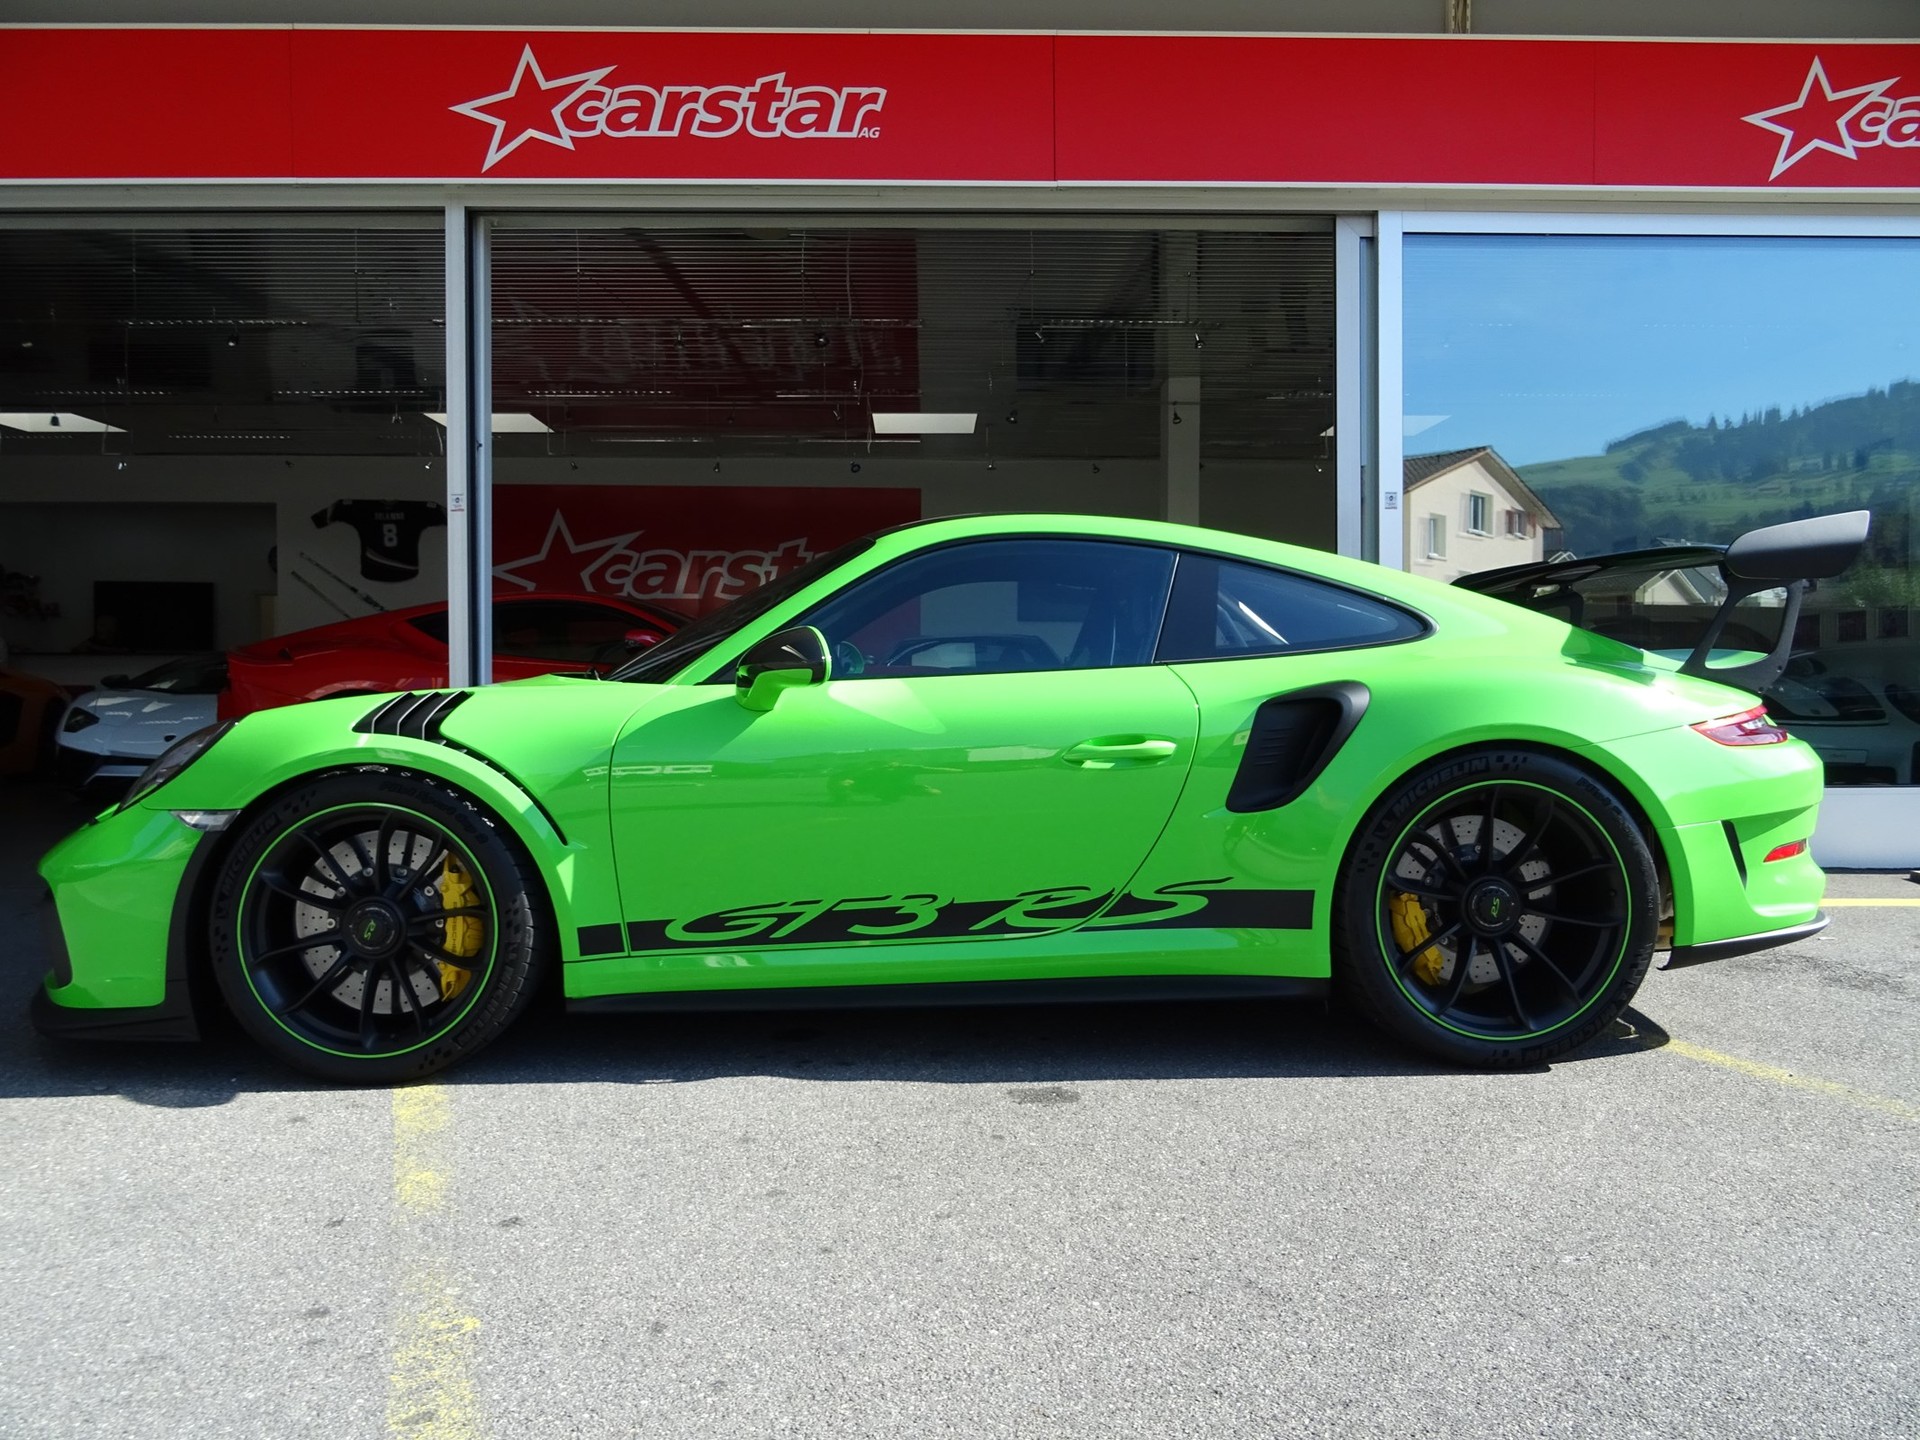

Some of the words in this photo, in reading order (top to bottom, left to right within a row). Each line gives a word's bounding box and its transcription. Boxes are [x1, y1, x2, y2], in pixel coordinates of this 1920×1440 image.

[561, 72, 888, 139] carstar
[858, 127, 880, 139] AG
[383, 523, 398, 547] 8
[600, 537, 832, 600] carst
[1391, 757, 1488, 817] MICHELIN
[221, 813, 277, 897] MICHELIN
[450, 901, 459, 953] PRSCHE
[665, 893, 945, 941] GT3
[968, 877, 1234, 930] RS
